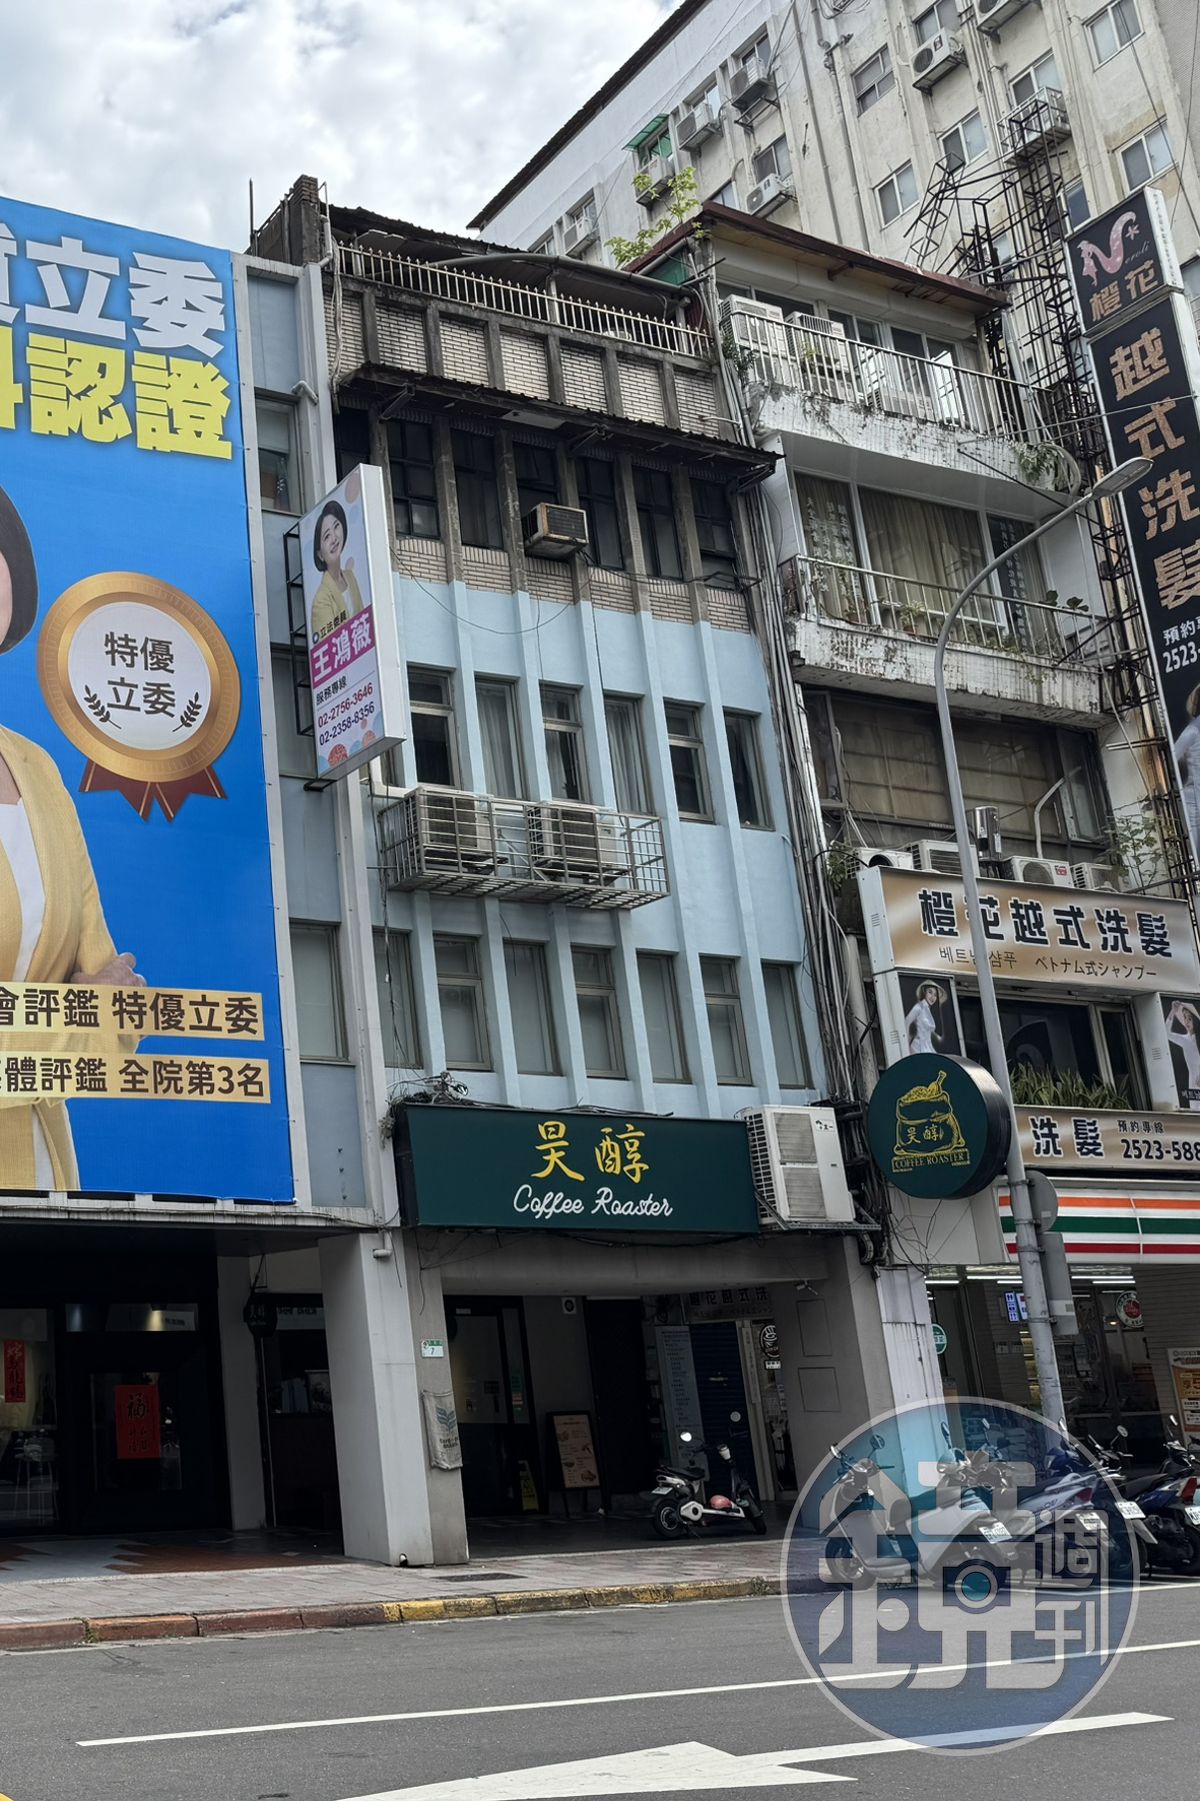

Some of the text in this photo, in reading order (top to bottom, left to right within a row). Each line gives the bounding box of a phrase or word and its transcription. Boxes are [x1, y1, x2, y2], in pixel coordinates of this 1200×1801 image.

[1089, 260, 1158, 322] 橙花
[104, 632, 175, 674] 特優
[313, 613, 372, 683] 王鴻薇
[107, 677, 176, 718] 立委
[316, 676, 347, 706] 服務專線
[318, 682, 373, 728] 02-2756-3646
[320, 701, 375, 746] 02-2358-8356
[918, 889, 1172, 958] 橙花越式洗髮
[112, 989, 259, 1035] 特優立委
[119, 1058, 265, 1099] 全院第3名
[1029, 1116, 1104, 1157] 洗髮
[1117, 1119, 1164, 1133] 預約專線
[531, 1120, 650, 1184] 昊醇
[895, 1153, 964, 1168] COFFEE ROASTER
[513, 1184, 672, 1219] Coffee Roaster
